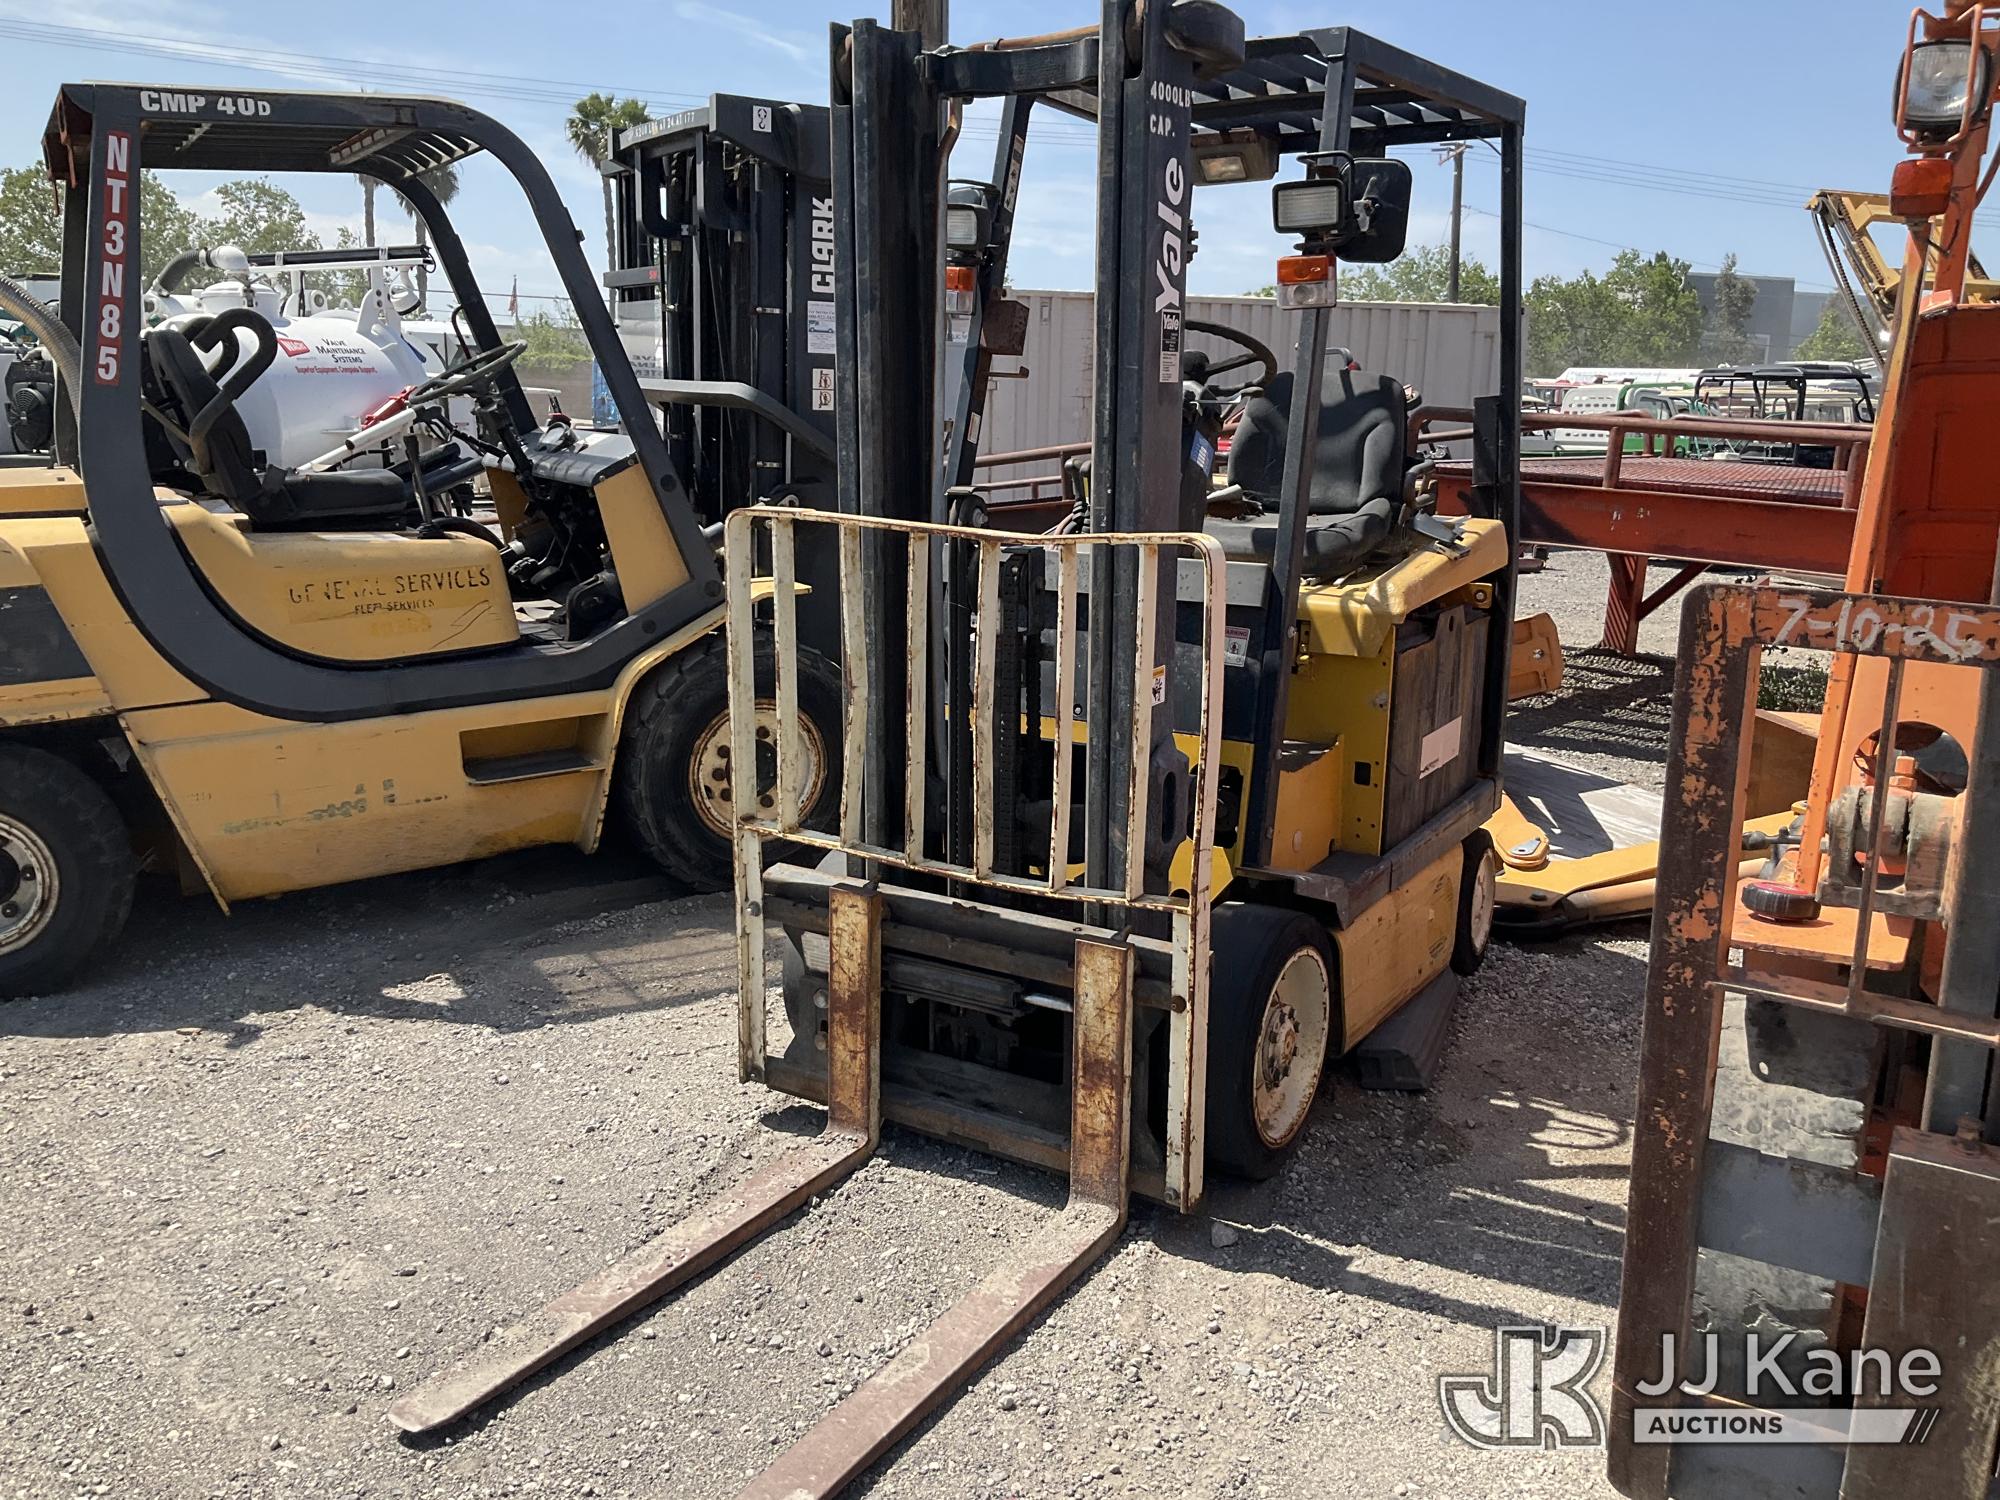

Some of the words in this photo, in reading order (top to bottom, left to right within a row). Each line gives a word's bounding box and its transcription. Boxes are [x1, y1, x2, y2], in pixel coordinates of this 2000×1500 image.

[140, 90, 206, 113] CMP
[1150, 80, 1191, 108] 4000LB
[1150, 113, 1176, 138] CAP.
[811, 196, 835, 294] CLARK
[1155, 157, 1184, 313] Yale
[97, 134, 129, 382] NT3N85
[1163, 313, 1180, 331] Yale
[331, 354, 363, 363] SYSTEMS
[395, 567, 491, 594] SERVICES
